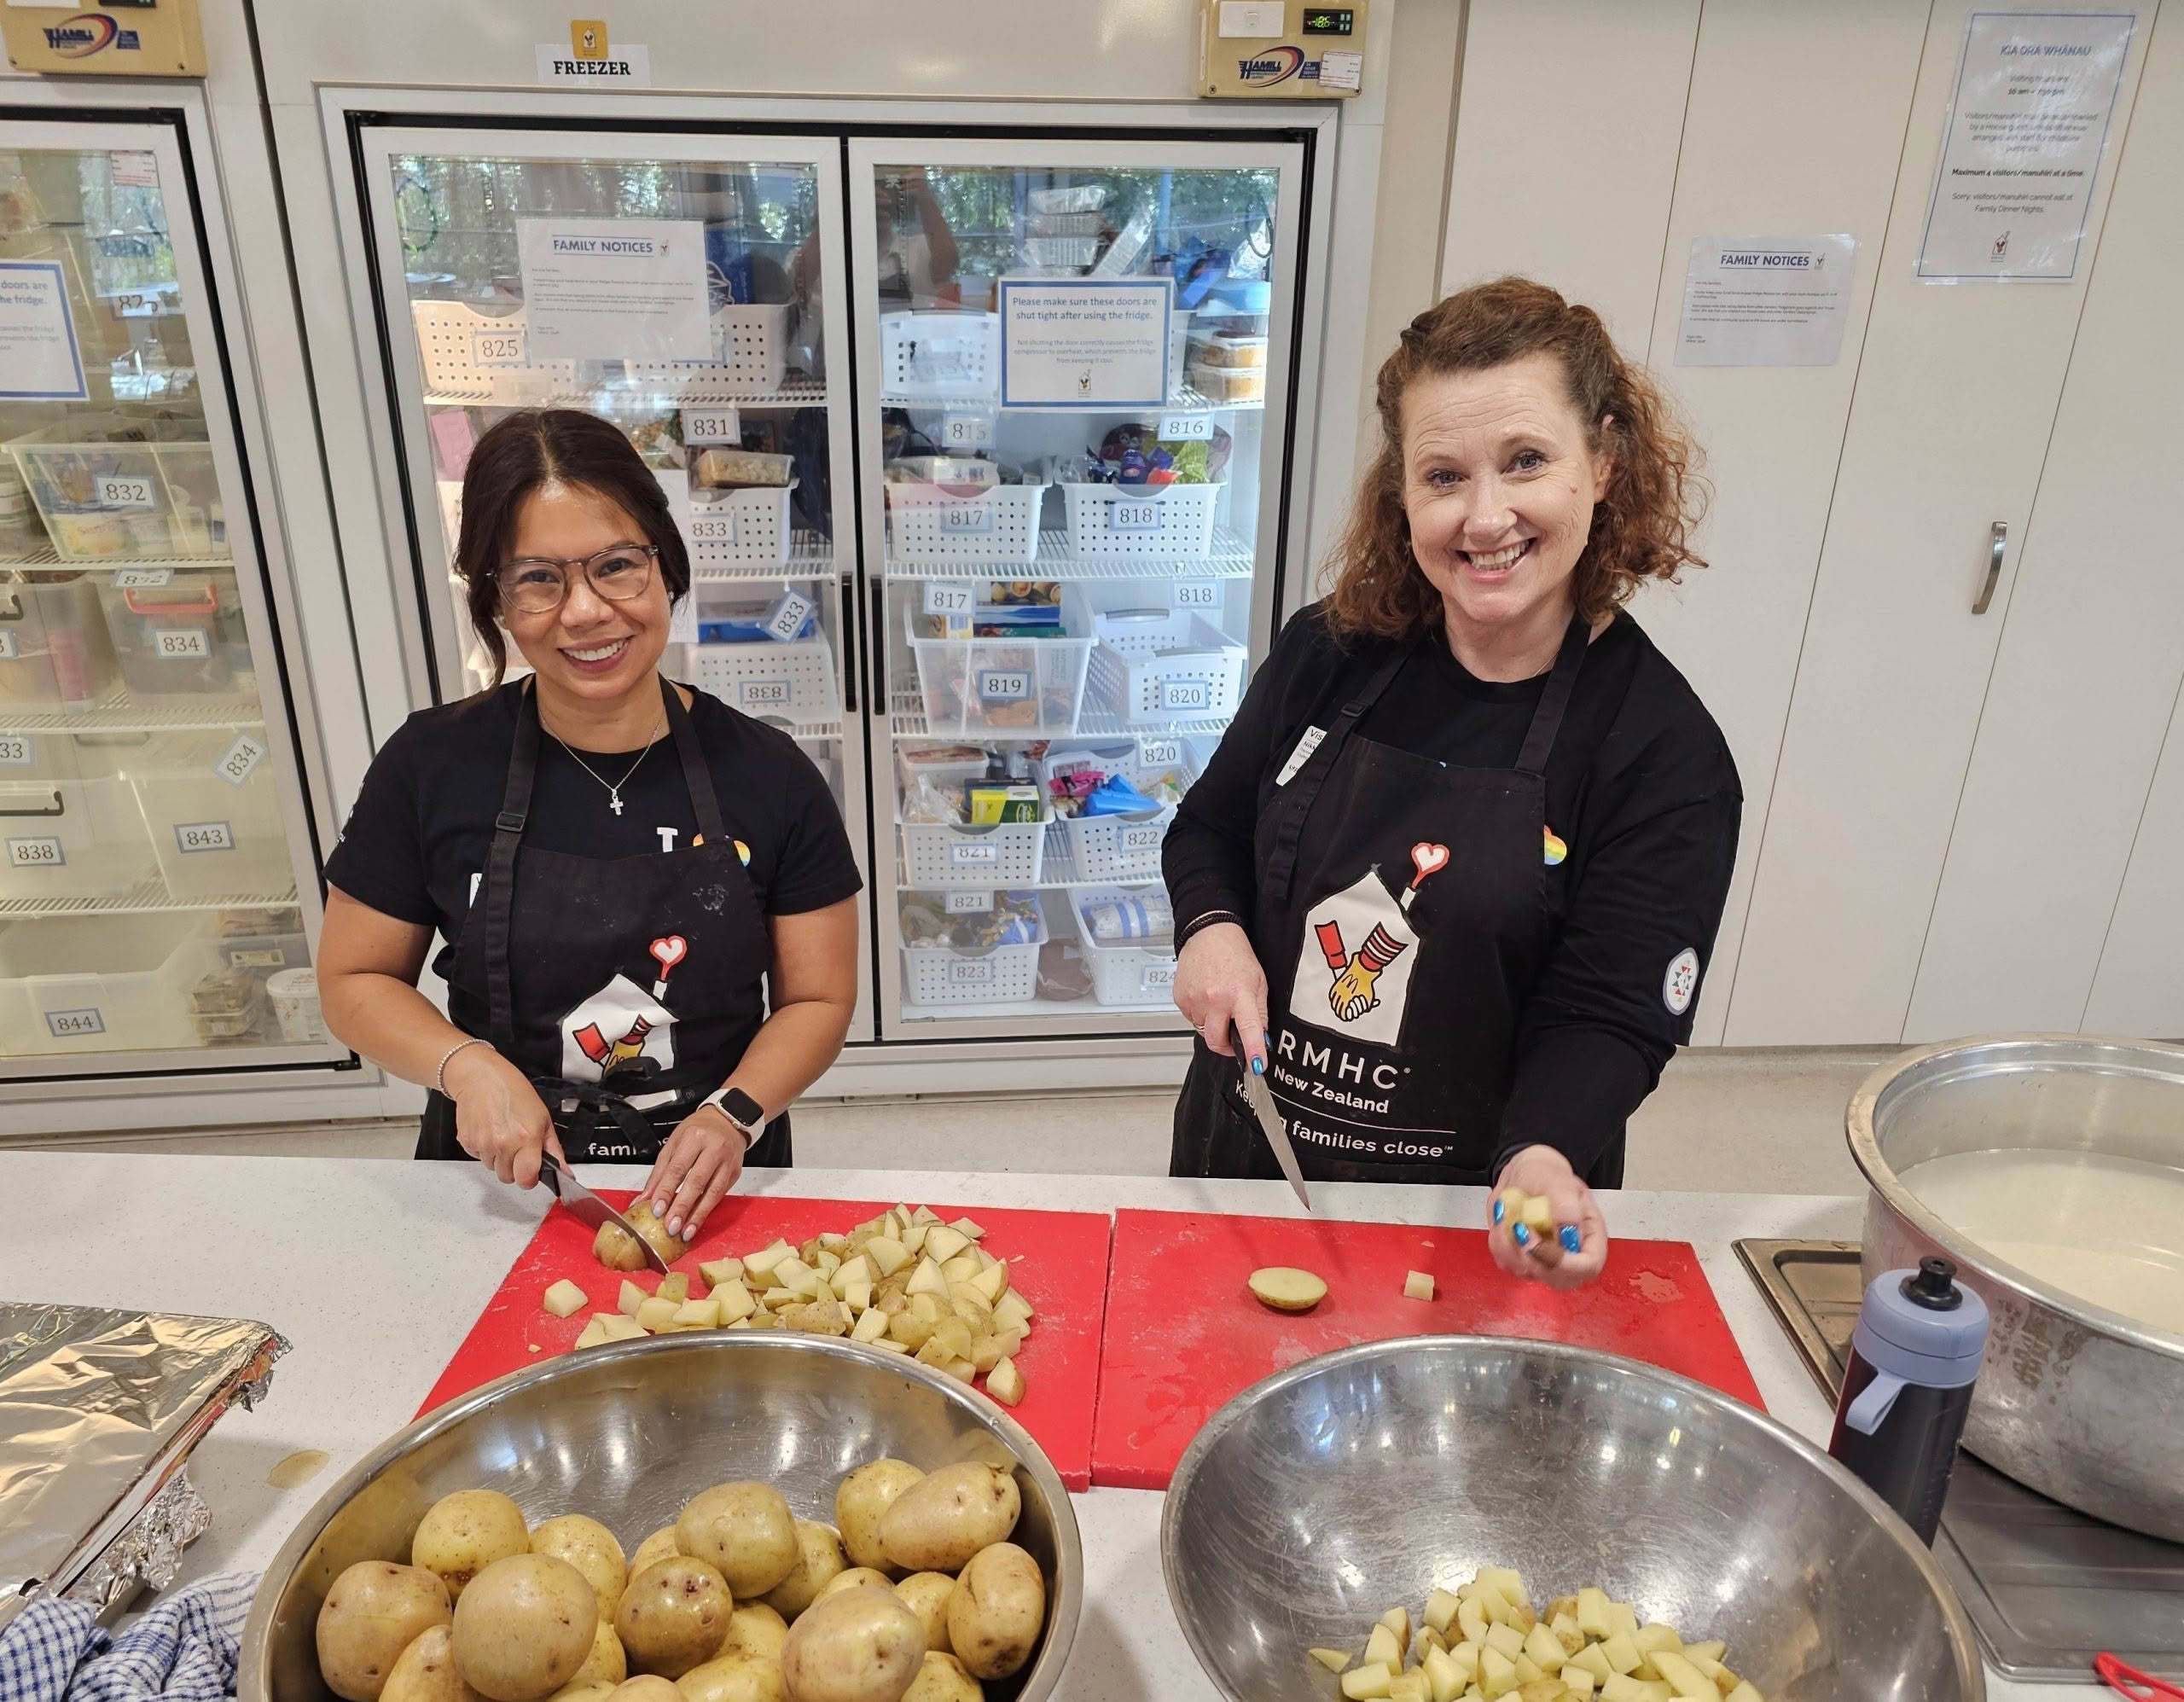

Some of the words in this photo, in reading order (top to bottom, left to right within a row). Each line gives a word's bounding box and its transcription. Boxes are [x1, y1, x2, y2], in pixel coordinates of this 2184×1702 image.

[554, 61, 631, 76] FREEZER
[1238, 61, 1281, 79] HAMILL
[1974, 205, 1996, 213] Family
[554, 240, 596, 252] FAMILY
[601, 241, 653, 253] NOTICES
[1720, 254, 1760, 265] FAMILY
[1763, 255, 1809, 266] NOTICES
[2, 280, 29, 289] doors
[0, 294, 13, 304] he
[1013, 297, 1041, 306] Please
[1043, 297, 1066, 306] make
[1090, 297, 1114, 306] these
[1116, 297, 1141, 306] doors
[1016, 311, 1036, 320] shut
[1037, 311, 1058, 322] tight
[1061, 311, 1081, 320] after
[1083, 312, 1107, 322] using
[1109, 311, 1124, 320] the
[1125, 311, 1153, 322] fridge.
[482, 340, 519, 357] 825
[694, 419, 729, 437] 831
[1169, 419, 1205, 435] 816
[106, 483, 146, 502] 832
[950, 509, 984, 526] 817
[1119, 507, 1153, 524] 818
[692, 522, 727, 537] 833
[933, 591, 967, 608] 817
[1179, 587, 1213, 603] 818
[777, 601, 804, 633] 833
[163, 636, 200, 653] 834
[989, 678, 1021, 693] 819
[1170, 688, 1200, 704] 820
[0, 742, 23, 758] 33
[1145, 746, 1176, 763] 820
[226, 744, 257, 777] 834
[186, 829, 224, 845] 843
[656, 827, 678, 853] T
[1128, 831, 1159, 845] 822
[17, 845, 54, 861] 838
[955, 896, 984, 908] 821
[956, 966, 985, 979] 823
[57, 1015, 95, 1031] 844
[1274, 1065, 1309, 1091] New
[1311, 1082, 1390, 1114] Zealand
[1292, 1120, 1376, 1152] families
